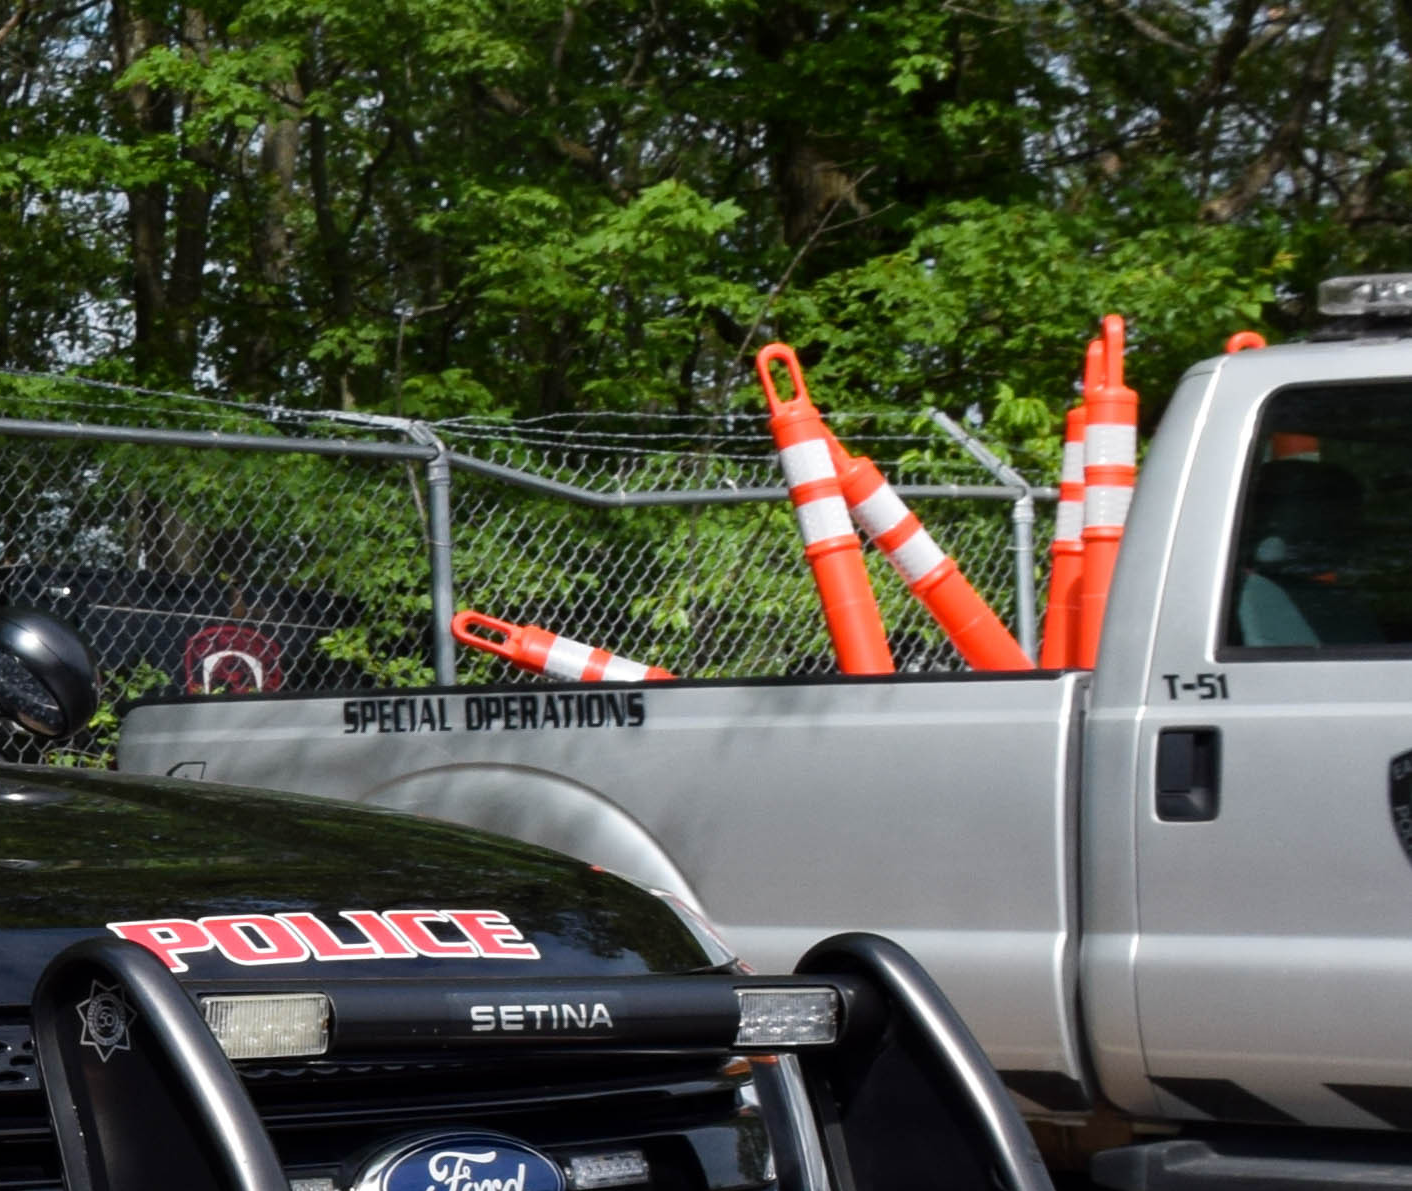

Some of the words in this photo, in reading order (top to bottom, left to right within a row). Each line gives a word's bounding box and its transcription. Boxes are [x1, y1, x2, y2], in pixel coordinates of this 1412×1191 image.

[1162, 674, 1229, 700] T-51
[344, 699, 452, 735] SPECIAL
[465, 692, 645, 731] OPERATIONS
[107, 910, 540, 973] POLICE
[471, 1003, 613, 1032] SETINA
